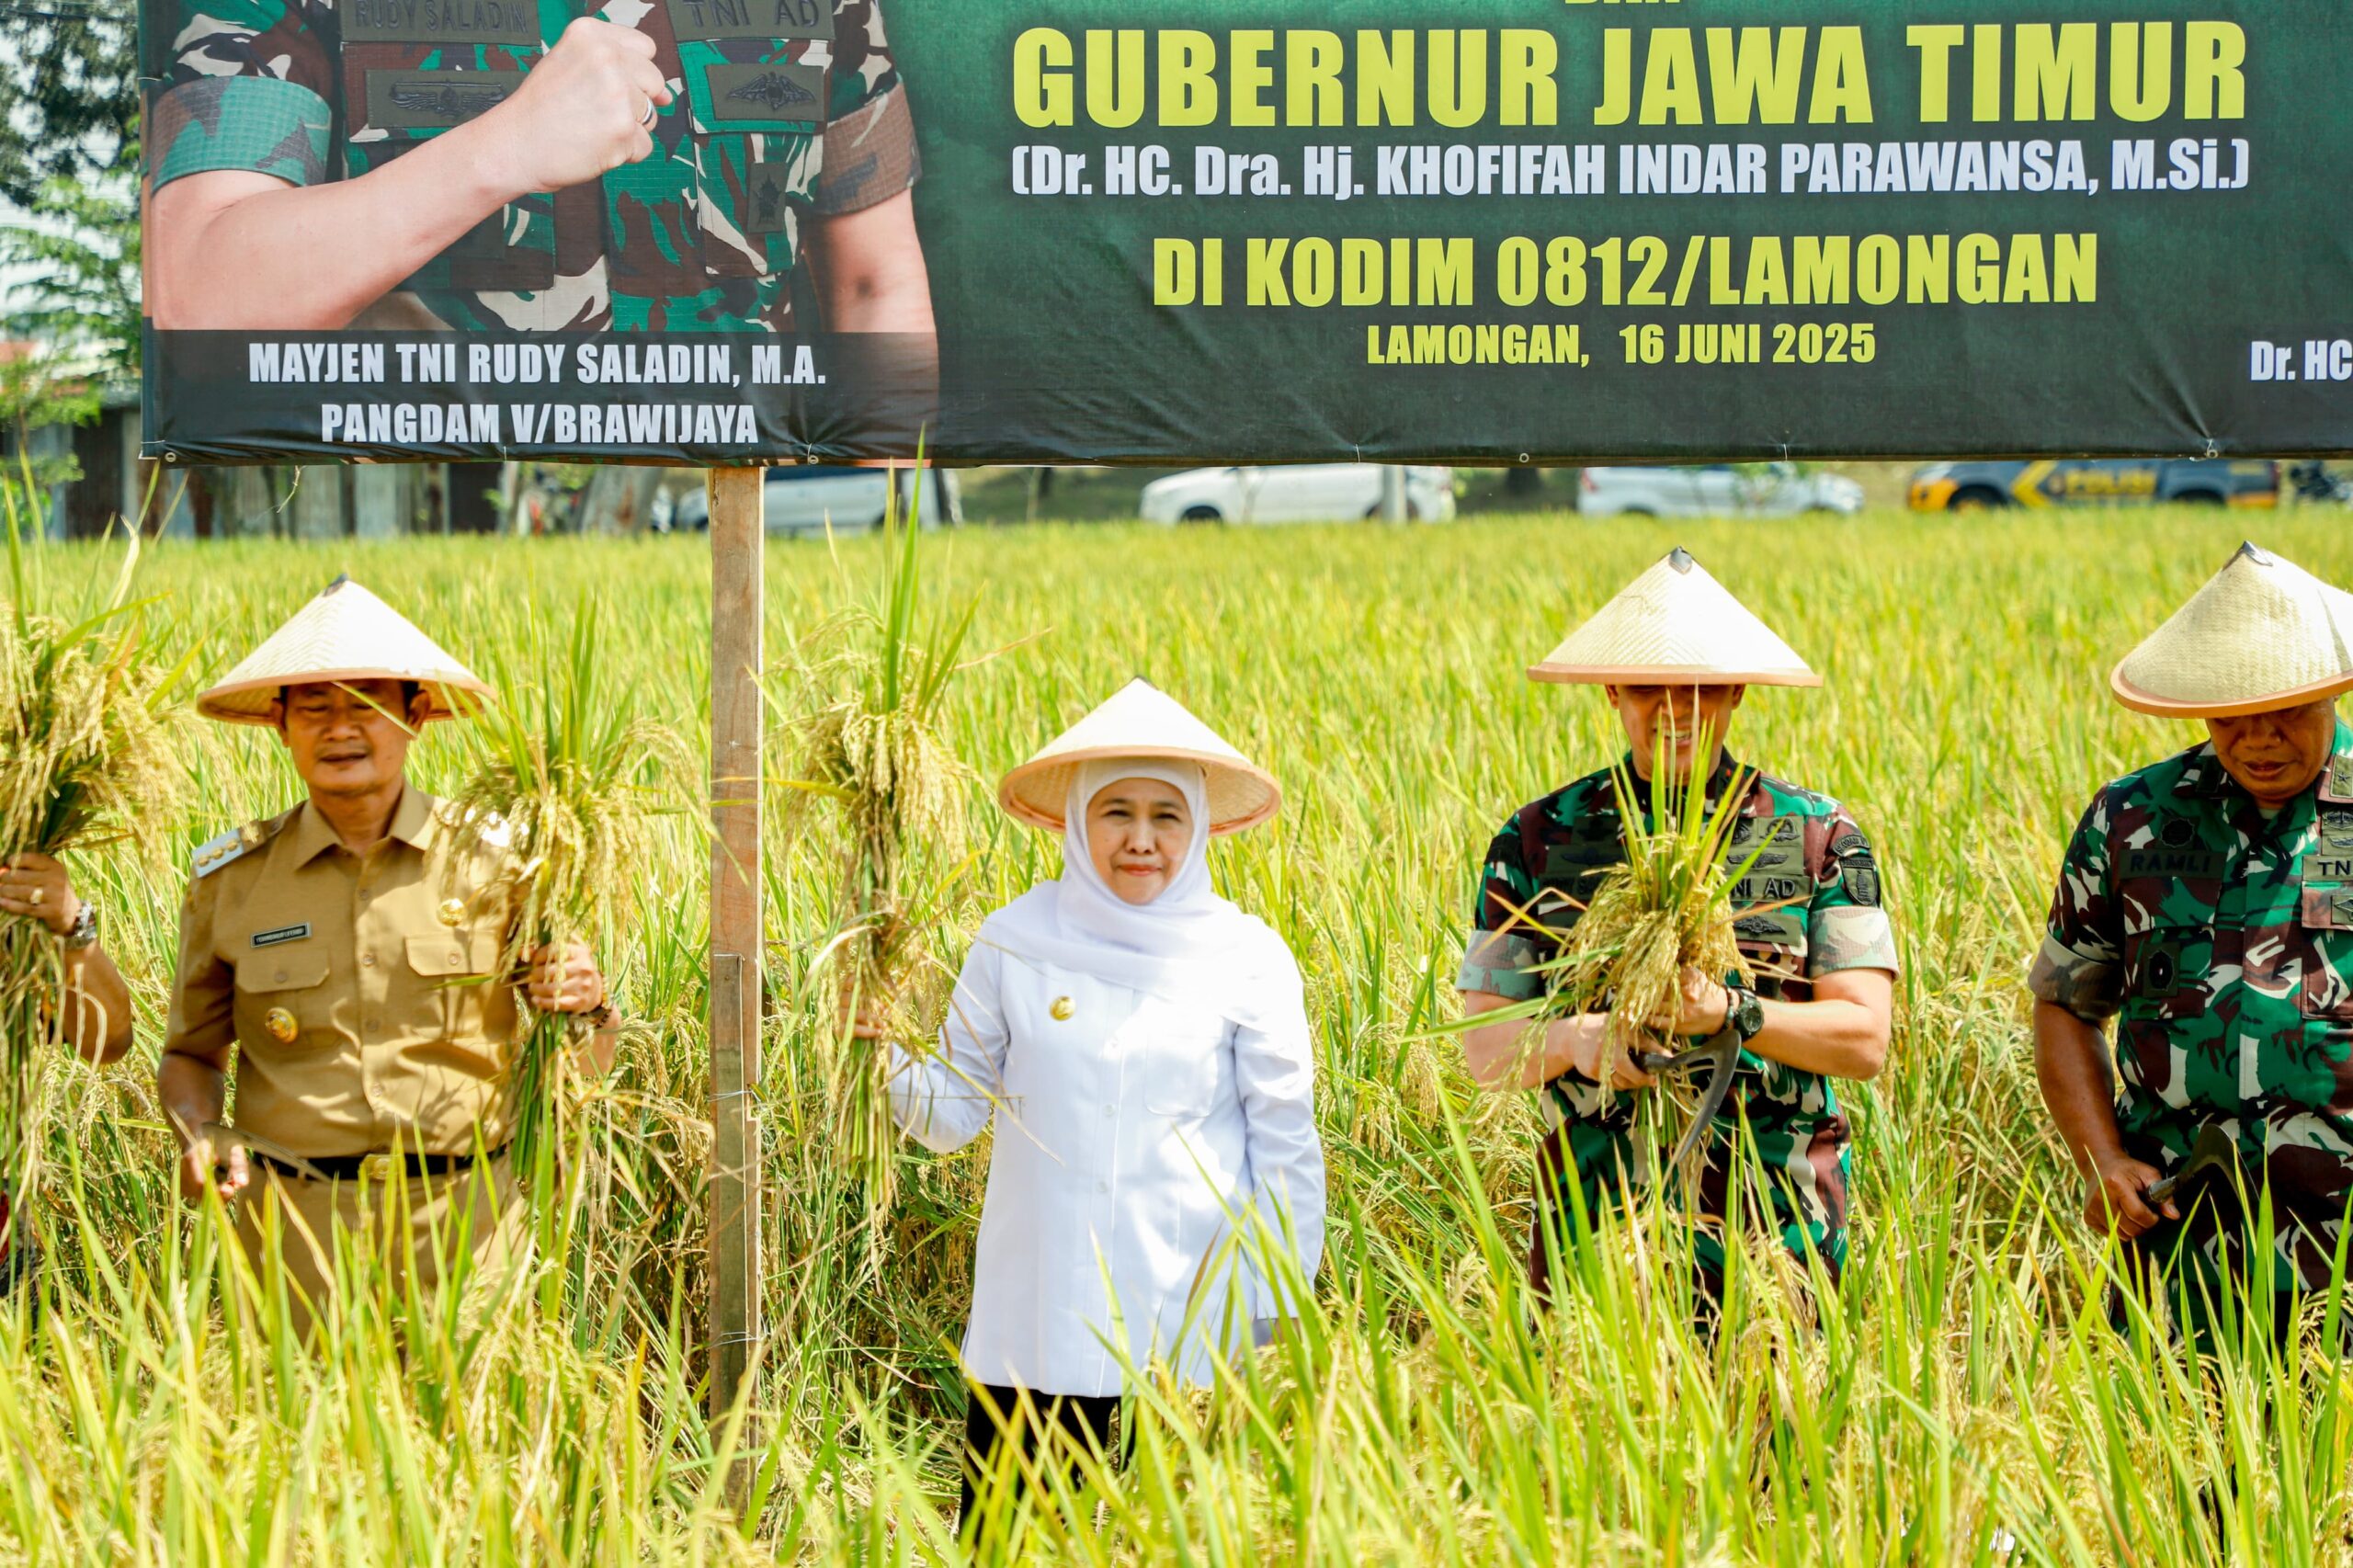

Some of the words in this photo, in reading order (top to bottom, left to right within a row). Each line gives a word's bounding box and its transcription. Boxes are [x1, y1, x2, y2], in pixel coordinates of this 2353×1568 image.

[426, 0, 529, 33] SALADIN
[684, 0, 751, 28] TNI
[775, 0, 820, 28] AD
[1013, 28, 1559, 128] GUBERNUR
[1593, 26, 1873, 125] JAWA
[1905, 21, 2246, 122] TIMUR
[1012, 145, 1093, 196] (Dr.
[1105, 145, 1183, 196] HC.
[1195, 145, 1291, 196] Dra.
[1303, 145, 1364, 201] Hj.
[1377, 144, 1606, 196] KHOFIFAH
[1619, 143, 1767, 194] INDAR
[1780, 140, 2099, 196] PARAWANSA,
[2111, 138, 2250, 190] M.Si.)
[1154, 238, 1222, 306] DI
[1246, 237, 1473, 307] KODIM
[1497, 233, 2097, 307] 0812/LAMONGAN
[248, 343, 384, 382] MAYJEN
[395, 343, 456, 383] TNI
[468, 344, 566, 384] RUDY
[576, 344, 741, 388] SALADIN,
[751, 345, 827, 385] M.A.
[1367, 324, 1589, 368] LAMONGAN,
[1620, 324, 1665, 364] 16
[1675, 324, 1761, 364] JUNI
[1772, 323, 1876, 364] 2025
[2251, 340, 2296, 381] Dr.
[321, 403, 501, 445] PANGDAM
[510, 403, 759, 445] V/BRAWIJAYA
[2130, 853, 2211, 873] RAMLI
[1764, 878, 1795, 899] AD
